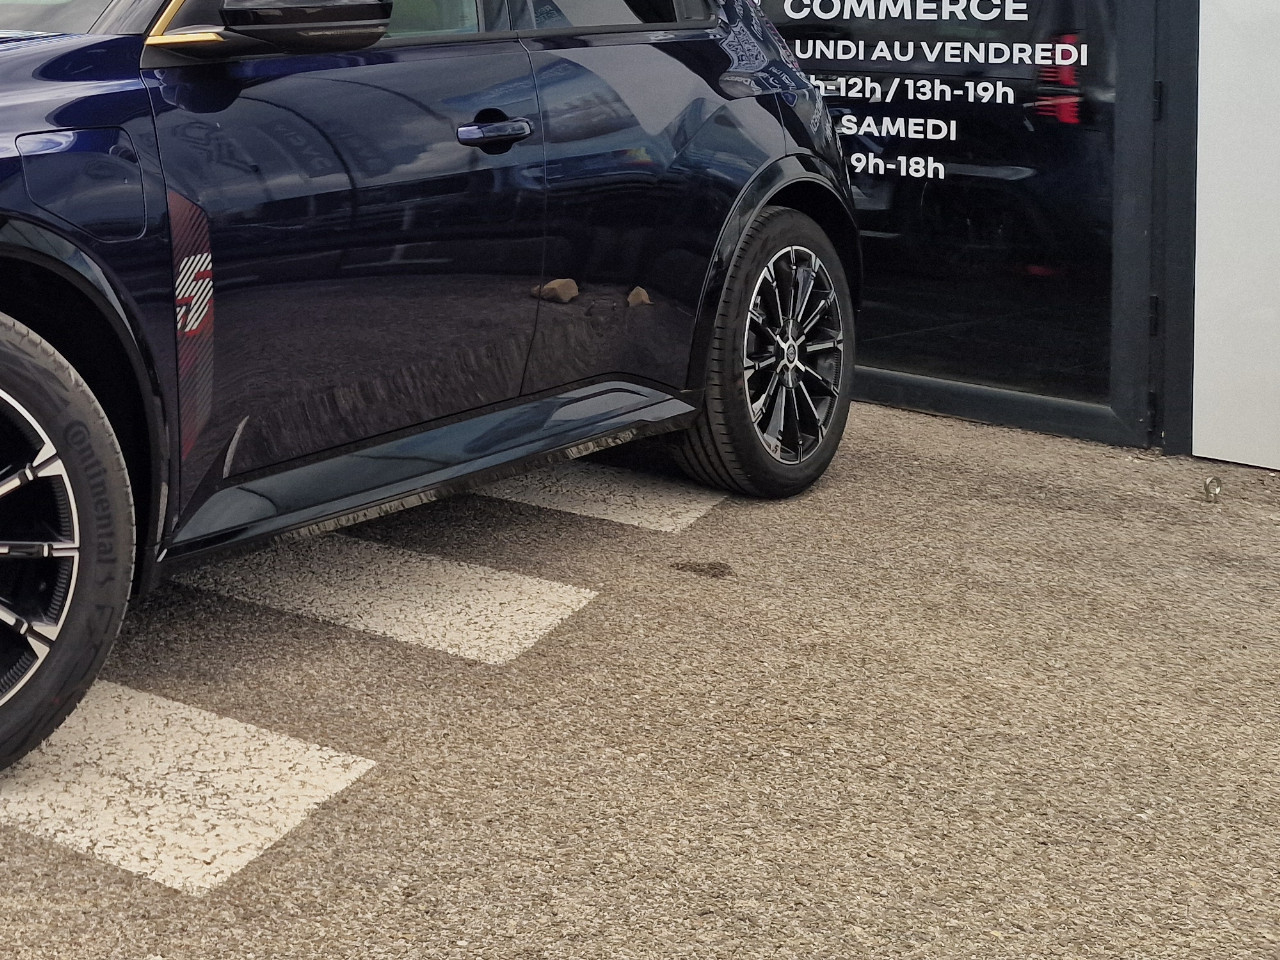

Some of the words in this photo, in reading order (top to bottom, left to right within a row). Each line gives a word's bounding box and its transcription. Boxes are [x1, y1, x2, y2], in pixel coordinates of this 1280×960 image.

[794, 39, 865, 60] UNDI
[870, 40, 915, 62] AU
[920, 41, 1089, 66] VENDREDI
[840, 114, 957, 141] SAMEDI
[850, 152, 945, 179] 9h-18h
